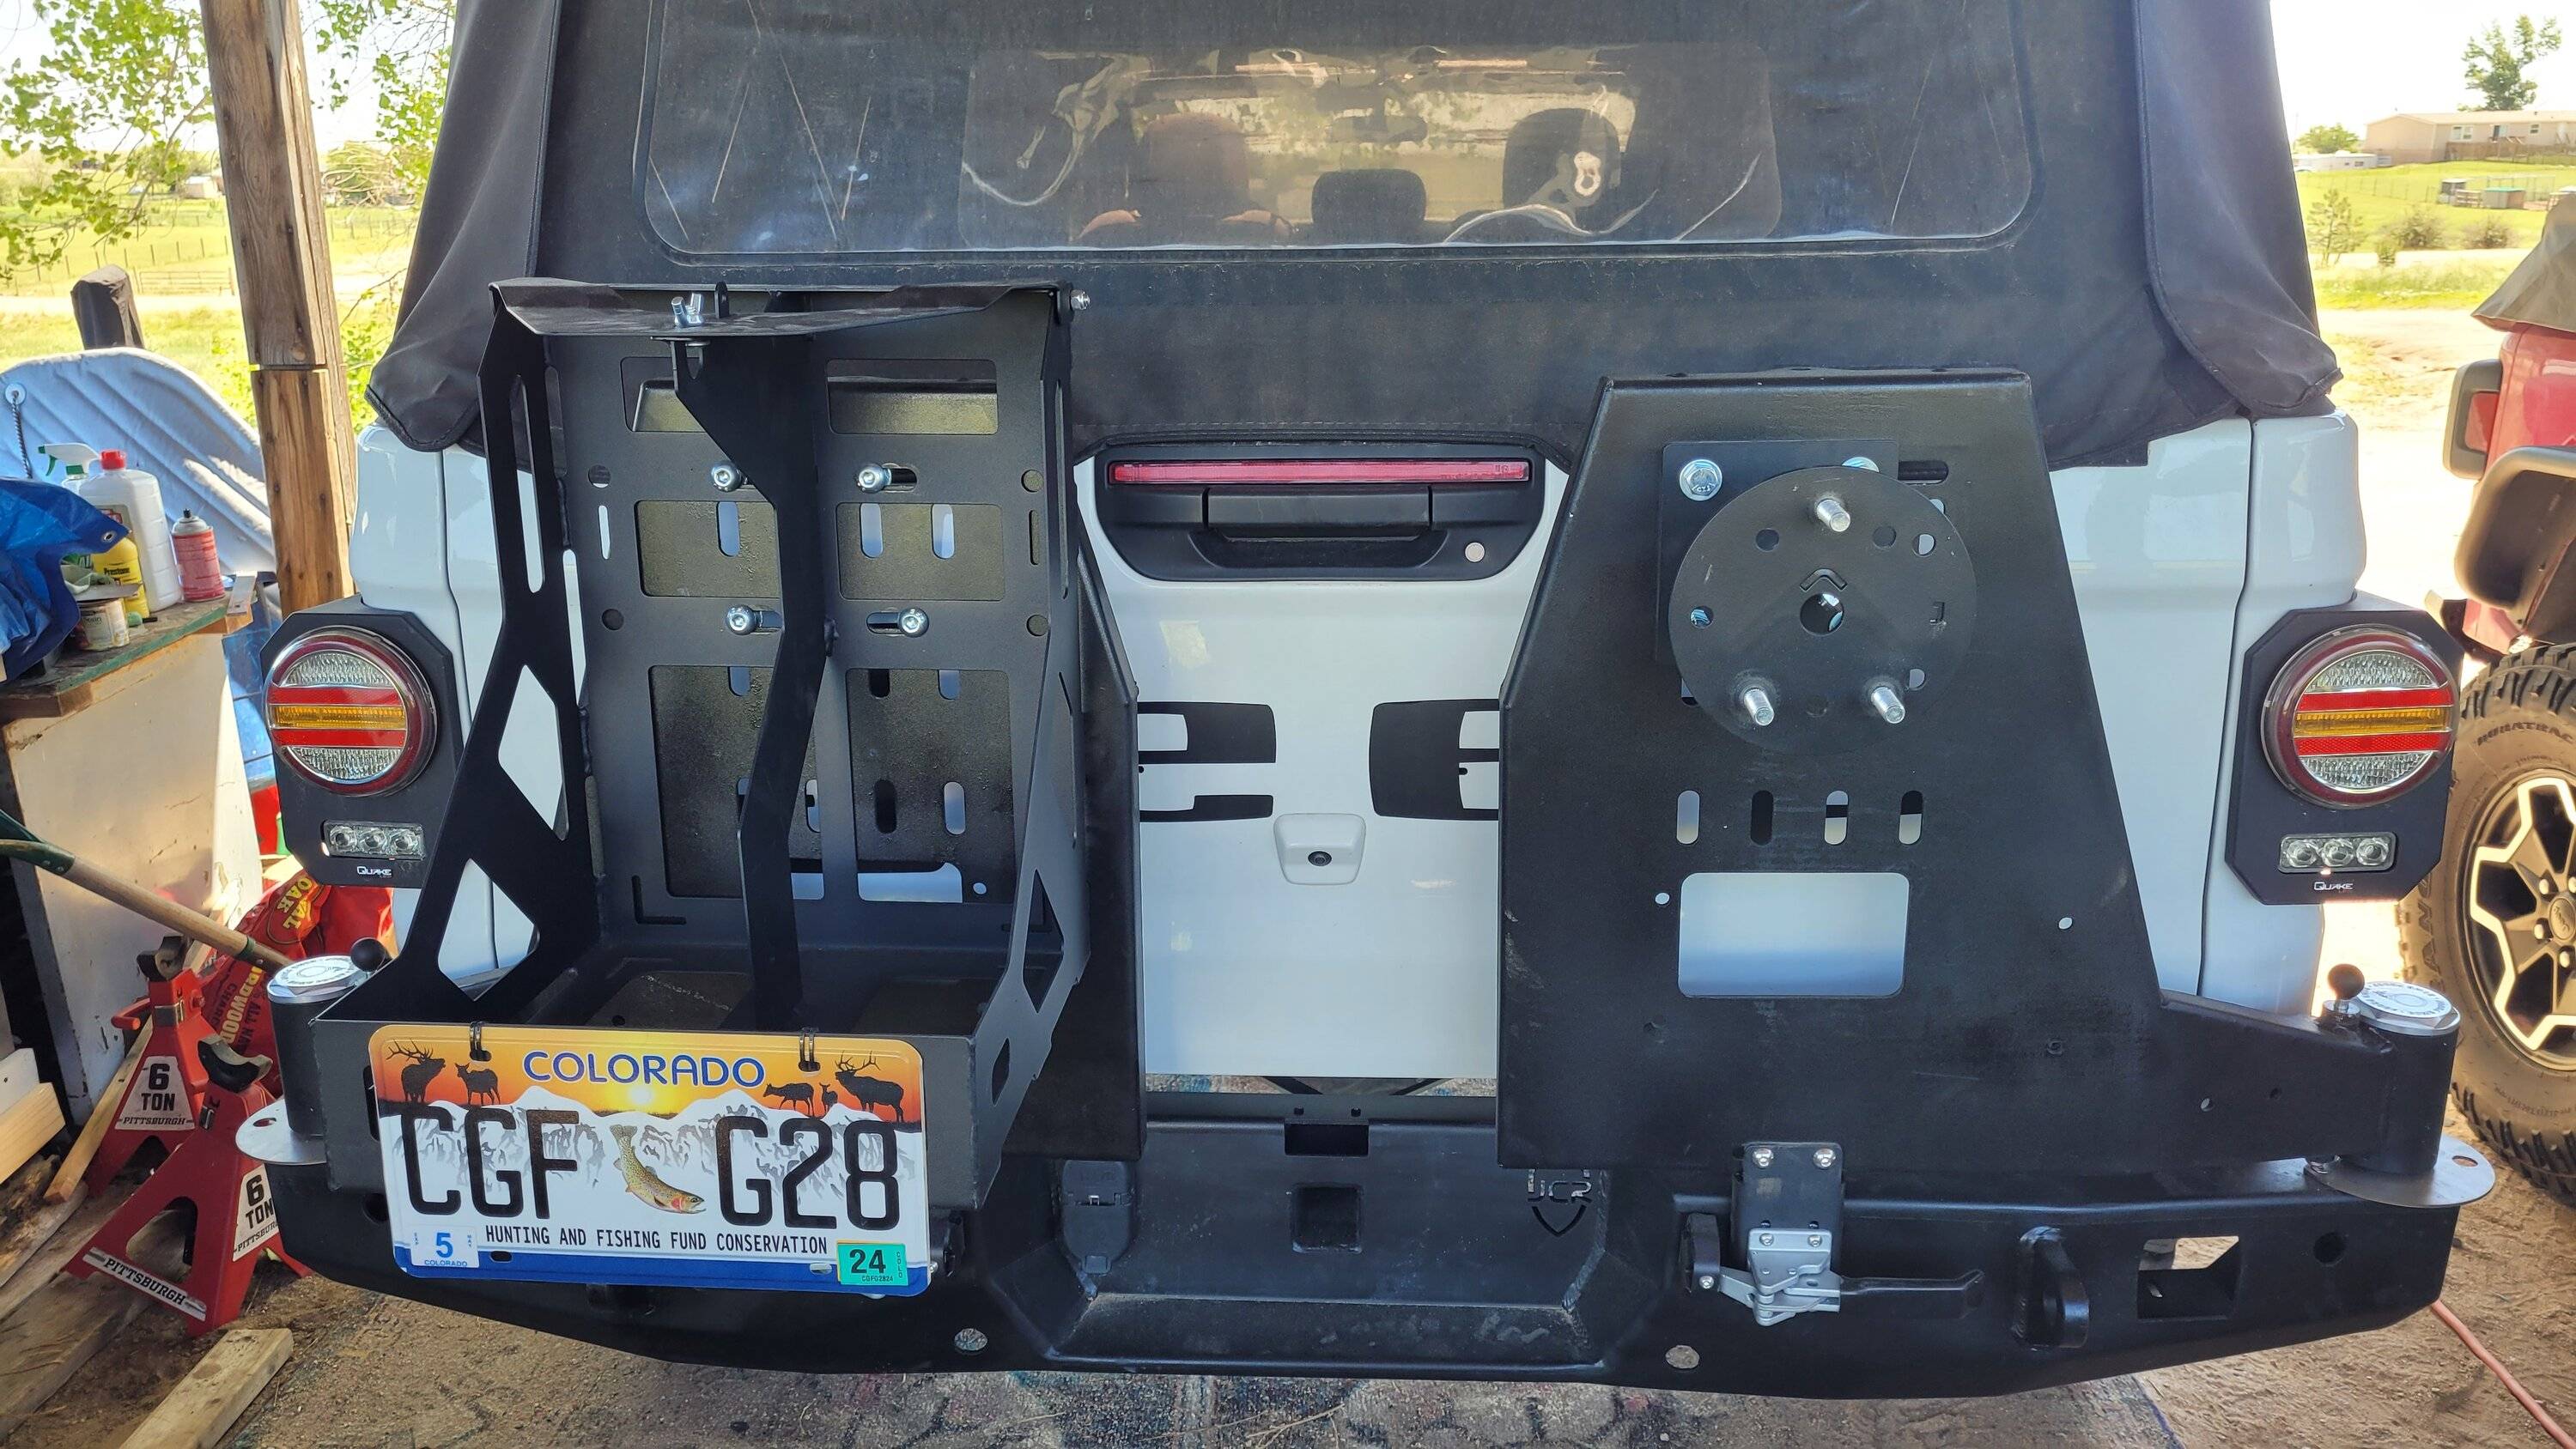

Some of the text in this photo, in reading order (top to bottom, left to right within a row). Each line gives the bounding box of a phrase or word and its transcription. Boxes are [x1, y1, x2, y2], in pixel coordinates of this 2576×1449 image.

[277, 877, 312, 913] OAK
[149, 1064, 170, 1090] 6
[523, 1052, 764, 1087] COLORADO
[141, 1093, 175, 1111] TON
[400, 1108, 900, 1229] CGF G28
[246, 1174, 264, 1206] 6
[246, 1197, 274, 1229] TON
[238, 1221, 278, 1252] PITTSBUR
[436, 1232, 453, 1258] 5
[485, 1225, 828, 1254] HUNTING AND FISHING FUND CONSERVATION
[849, 1249, 886, 1274] 24
[104, 1258, 185, 1305] PITTSBURGH
